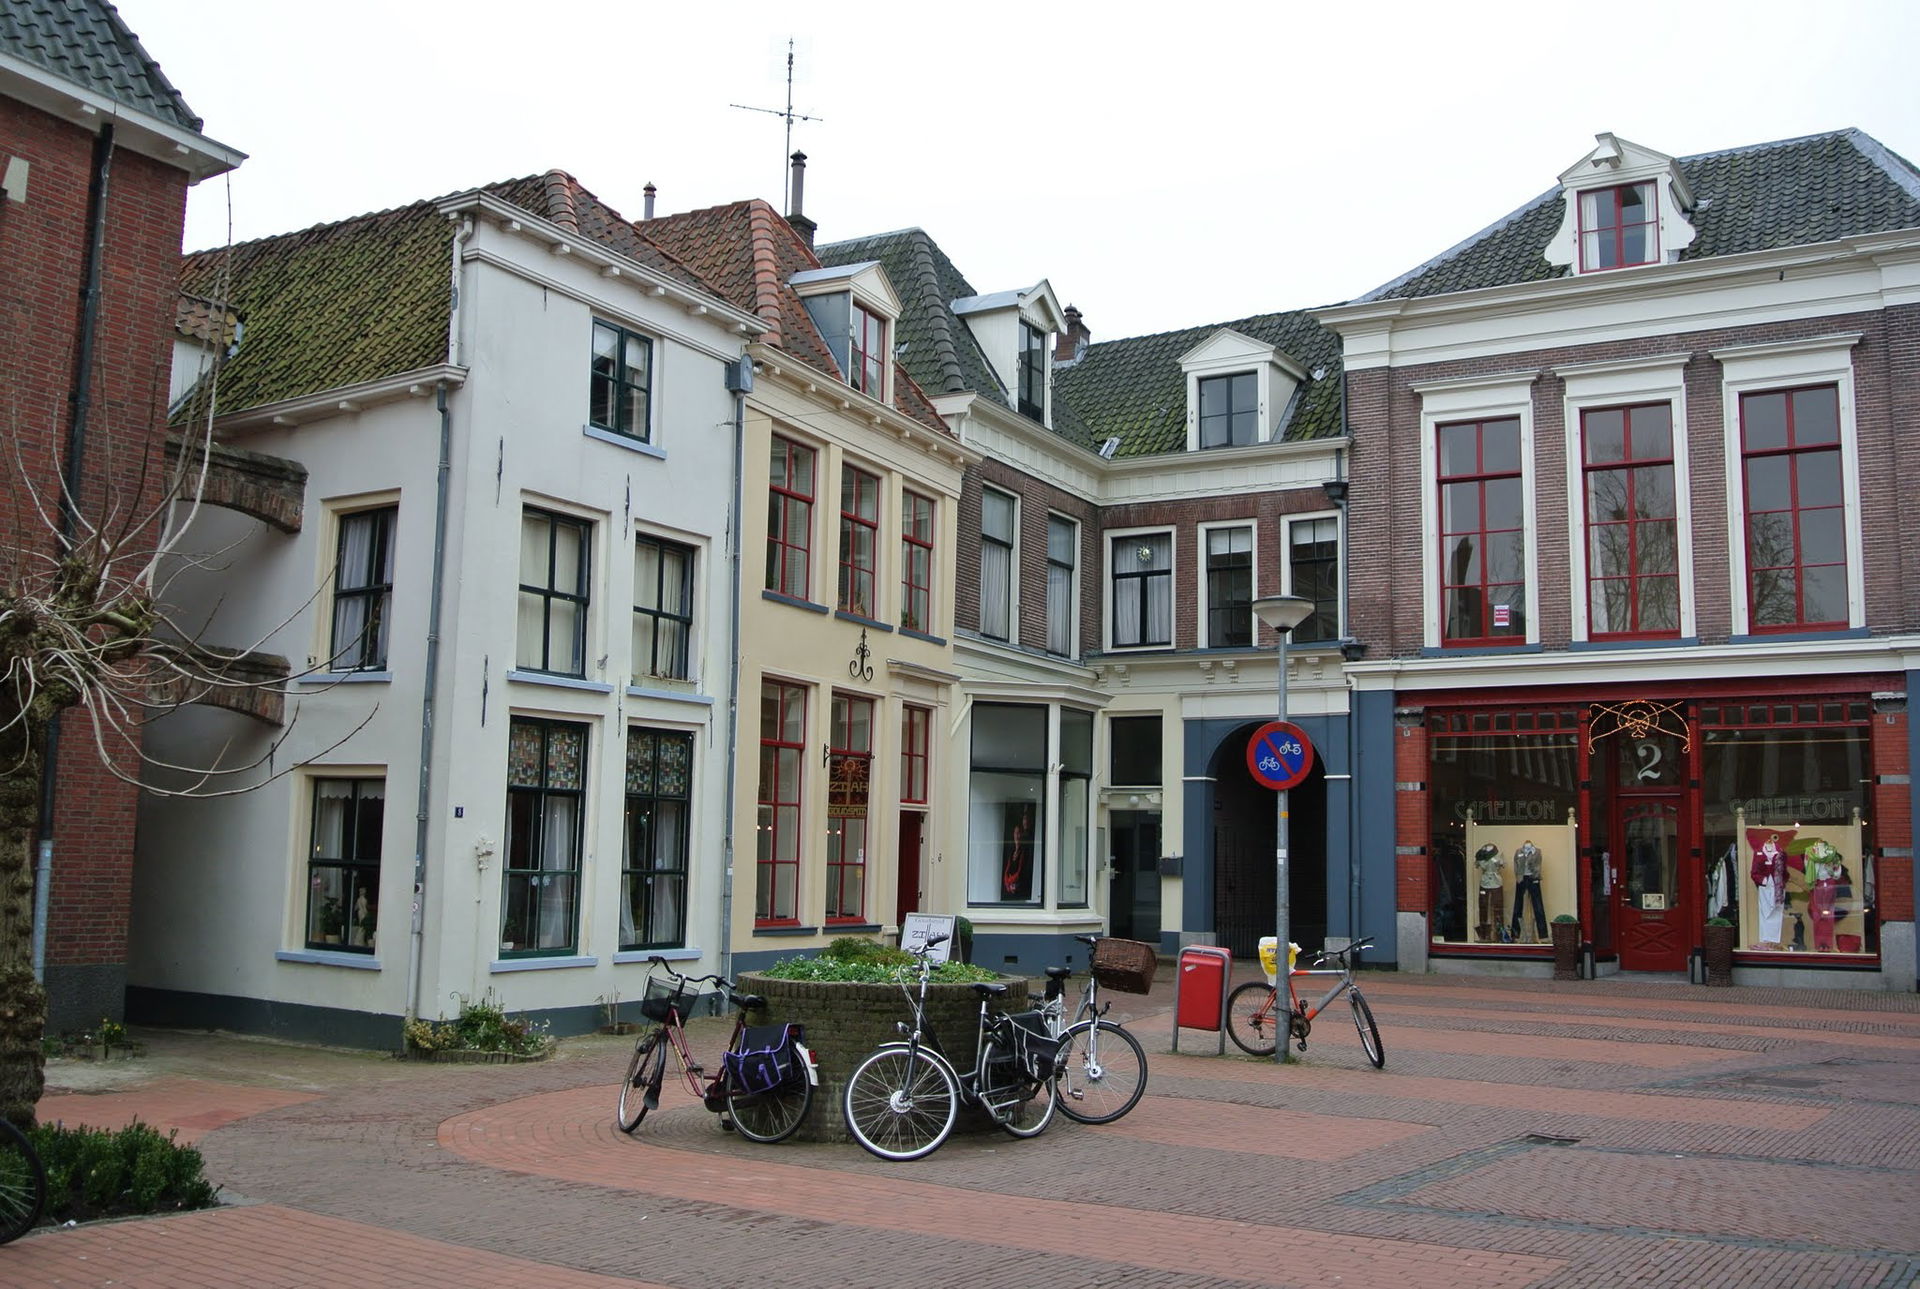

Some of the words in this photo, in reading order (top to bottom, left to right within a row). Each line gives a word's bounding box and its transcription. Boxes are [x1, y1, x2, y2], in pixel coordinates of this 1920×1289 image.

[1637, 744, 1662, 780] 2
[1455, 800, 1555, 819] CAMELEON
[1729, 798, 1845, 819] CAMELEON
